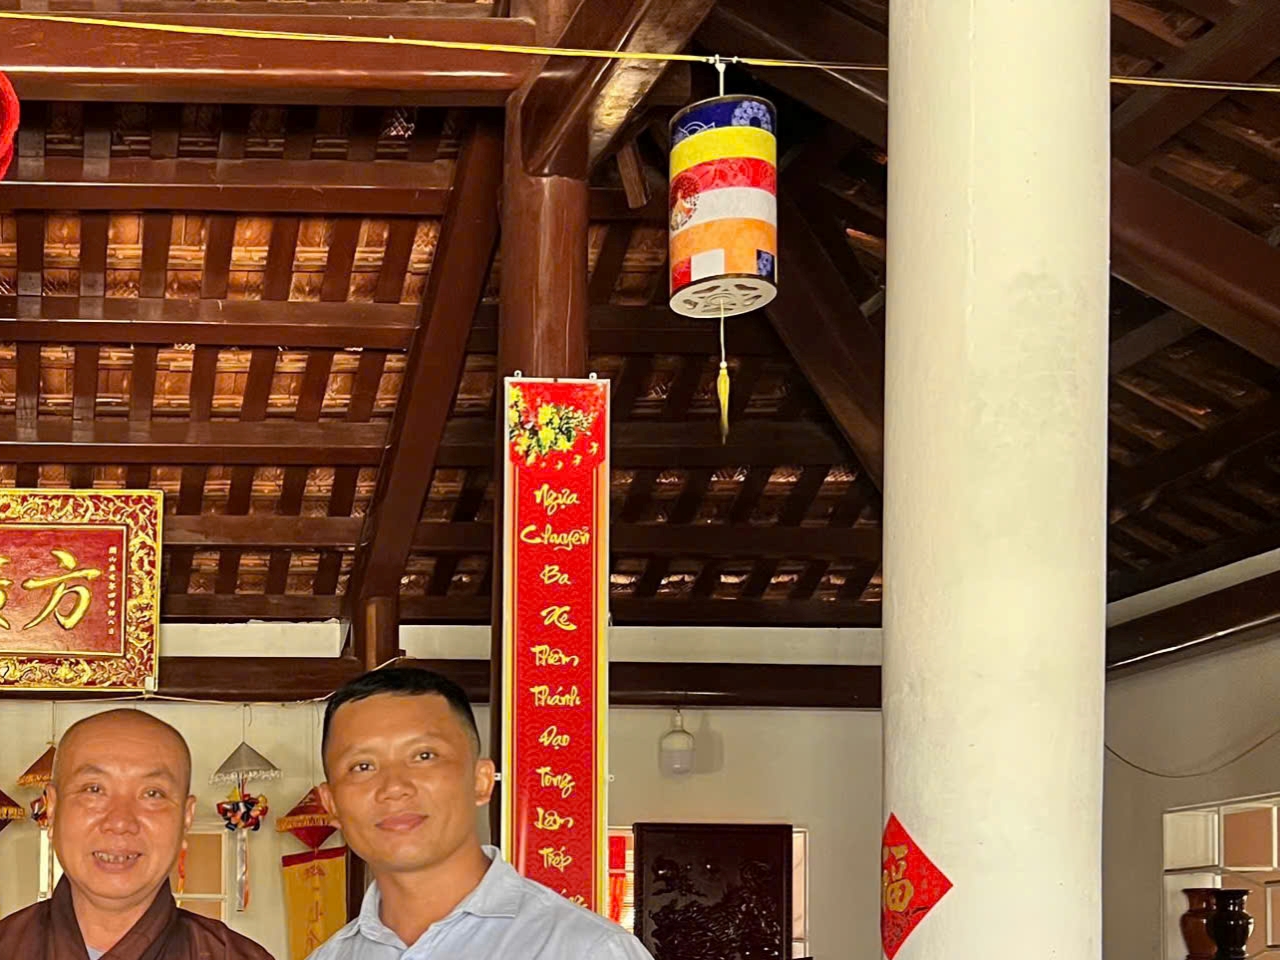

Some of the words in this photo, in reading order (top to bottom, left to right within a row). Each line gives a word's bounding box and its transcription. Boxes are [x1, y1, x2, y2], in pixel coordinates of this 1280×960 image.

[533, 483, 580, 516] Ngựa
[539, 564, 572, 585] Ba
[540, 605, 578, 631] Xe
[529, 684, 581, 707] Thánh
[538, 725, 571, 750] Đạo
[533, 807, 574, 831] Lâm
[538, 846, 573, 873] Tiếp
